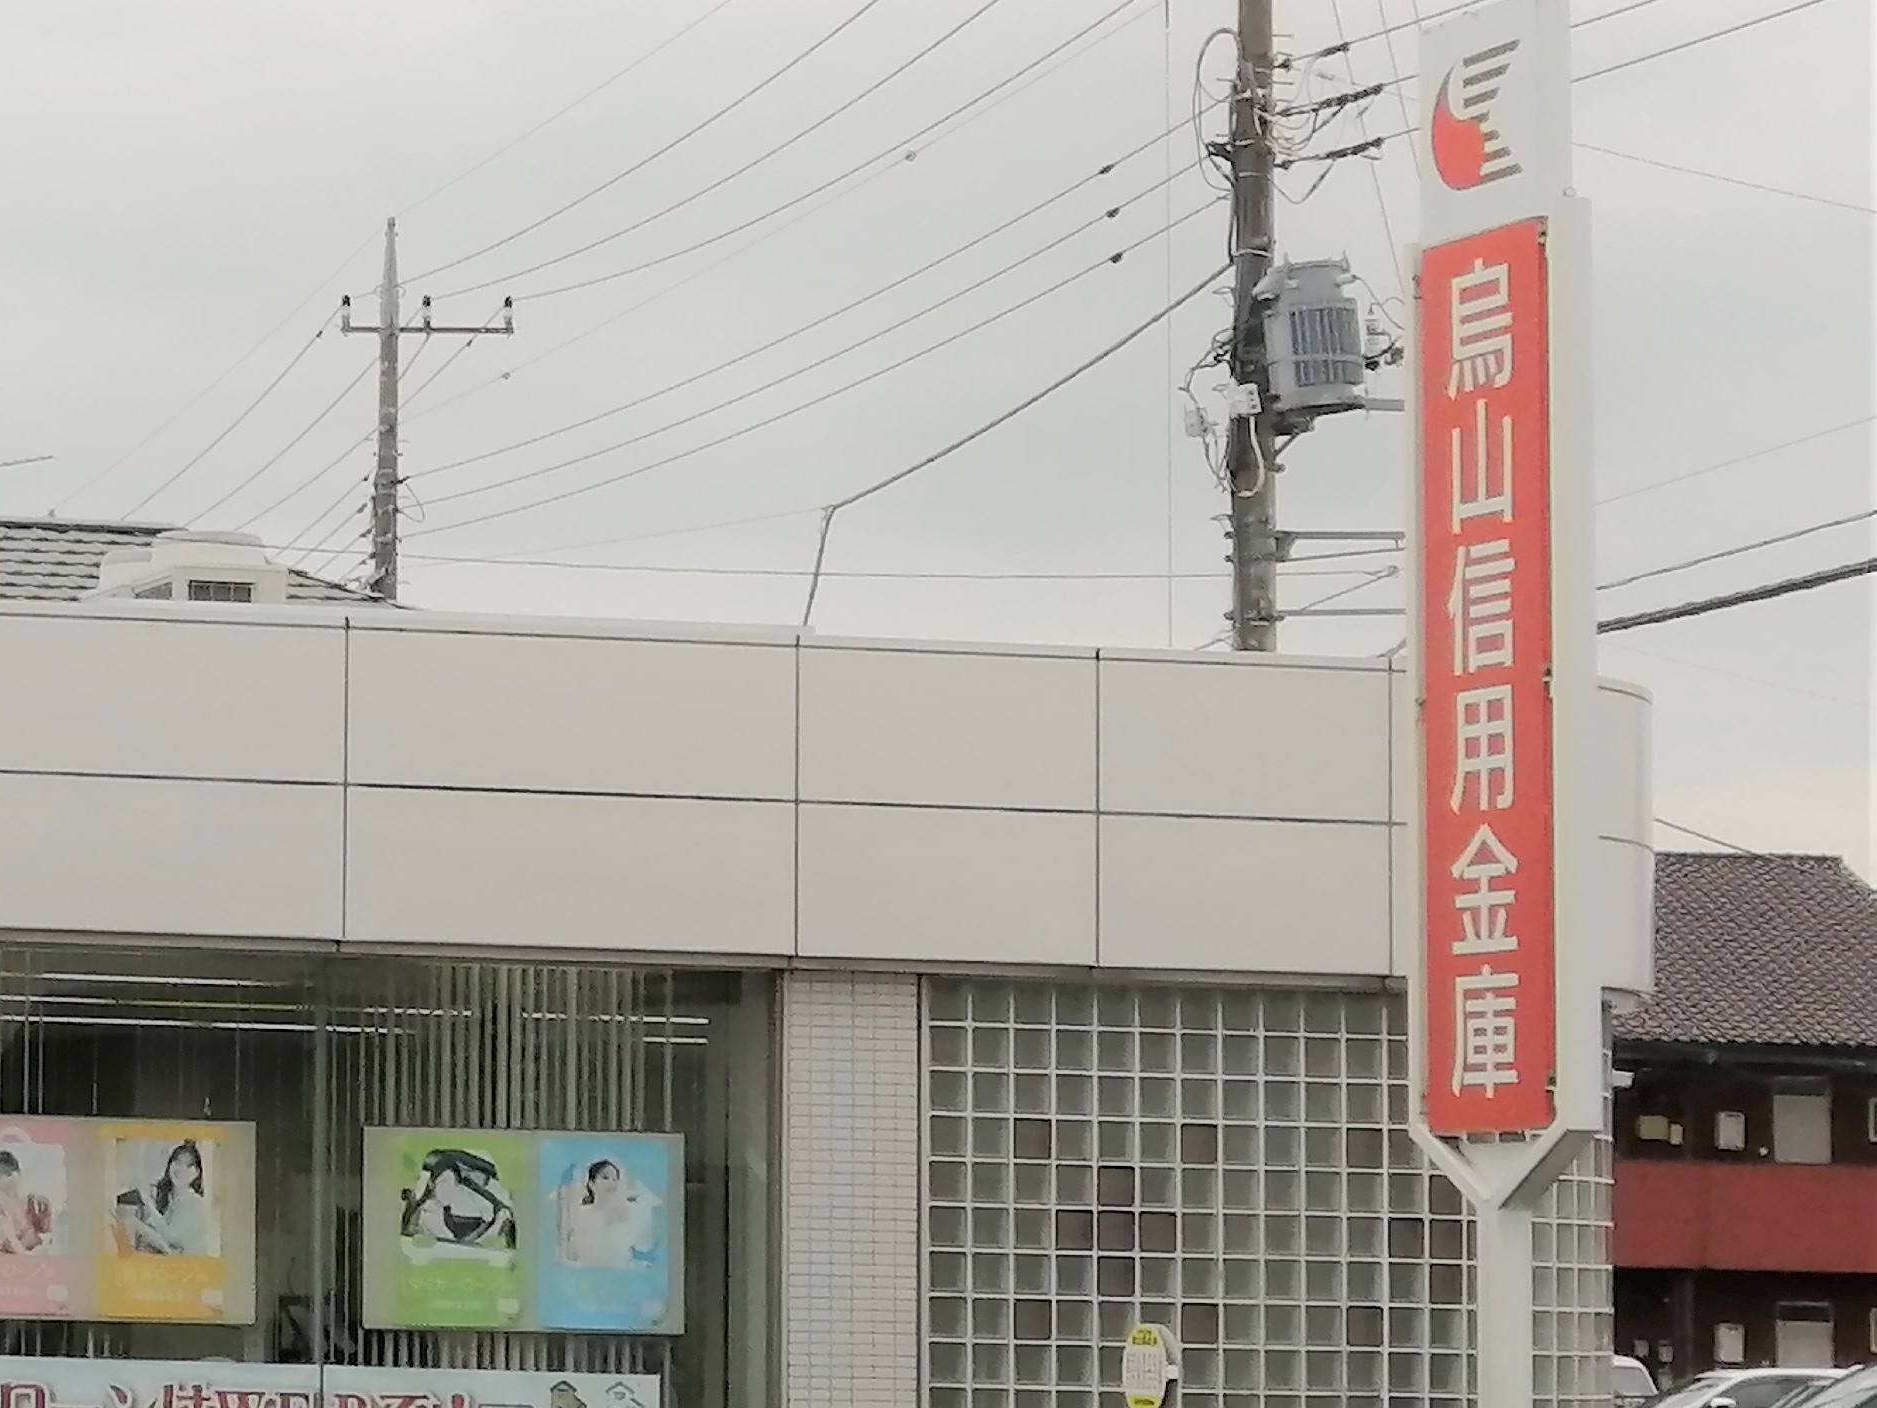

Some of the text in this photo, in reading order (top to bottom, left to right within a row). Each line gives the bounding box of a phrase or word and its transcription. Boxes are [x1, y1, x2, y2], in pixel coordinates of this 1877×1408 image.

[1445, 256, 1519, 1100] 烏山信用金庫
